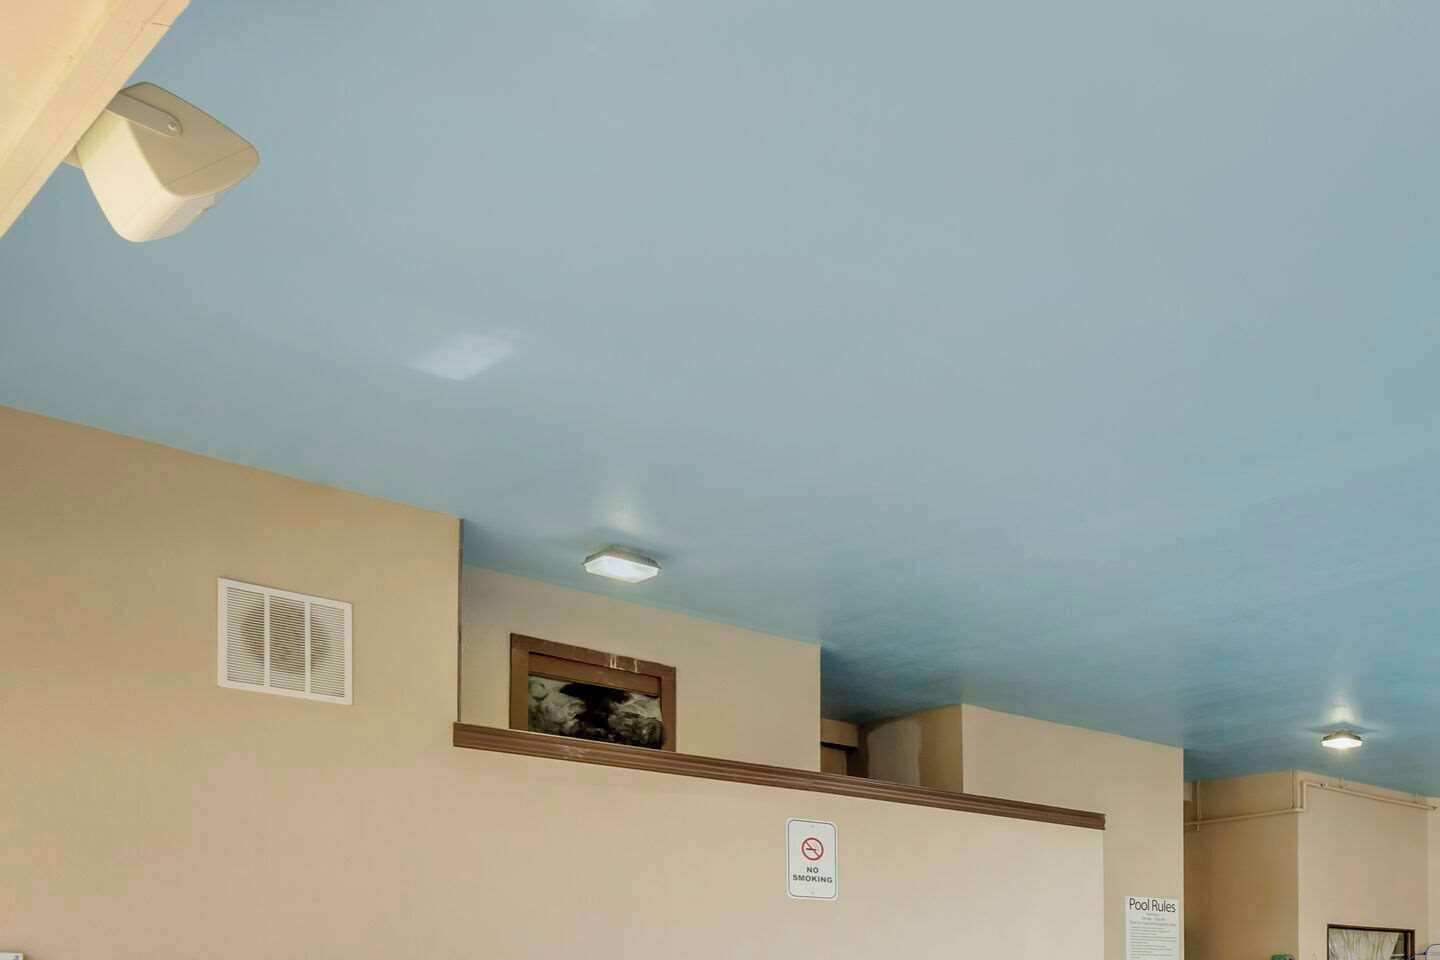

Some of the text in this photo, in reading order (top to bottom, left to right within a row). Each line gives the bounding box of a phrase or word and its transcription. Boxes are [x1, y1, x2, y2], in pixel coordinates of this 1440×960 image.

[792, 874, 833, 884] SMOKING
[1129, 897, 1177, 913] Pool Rules
